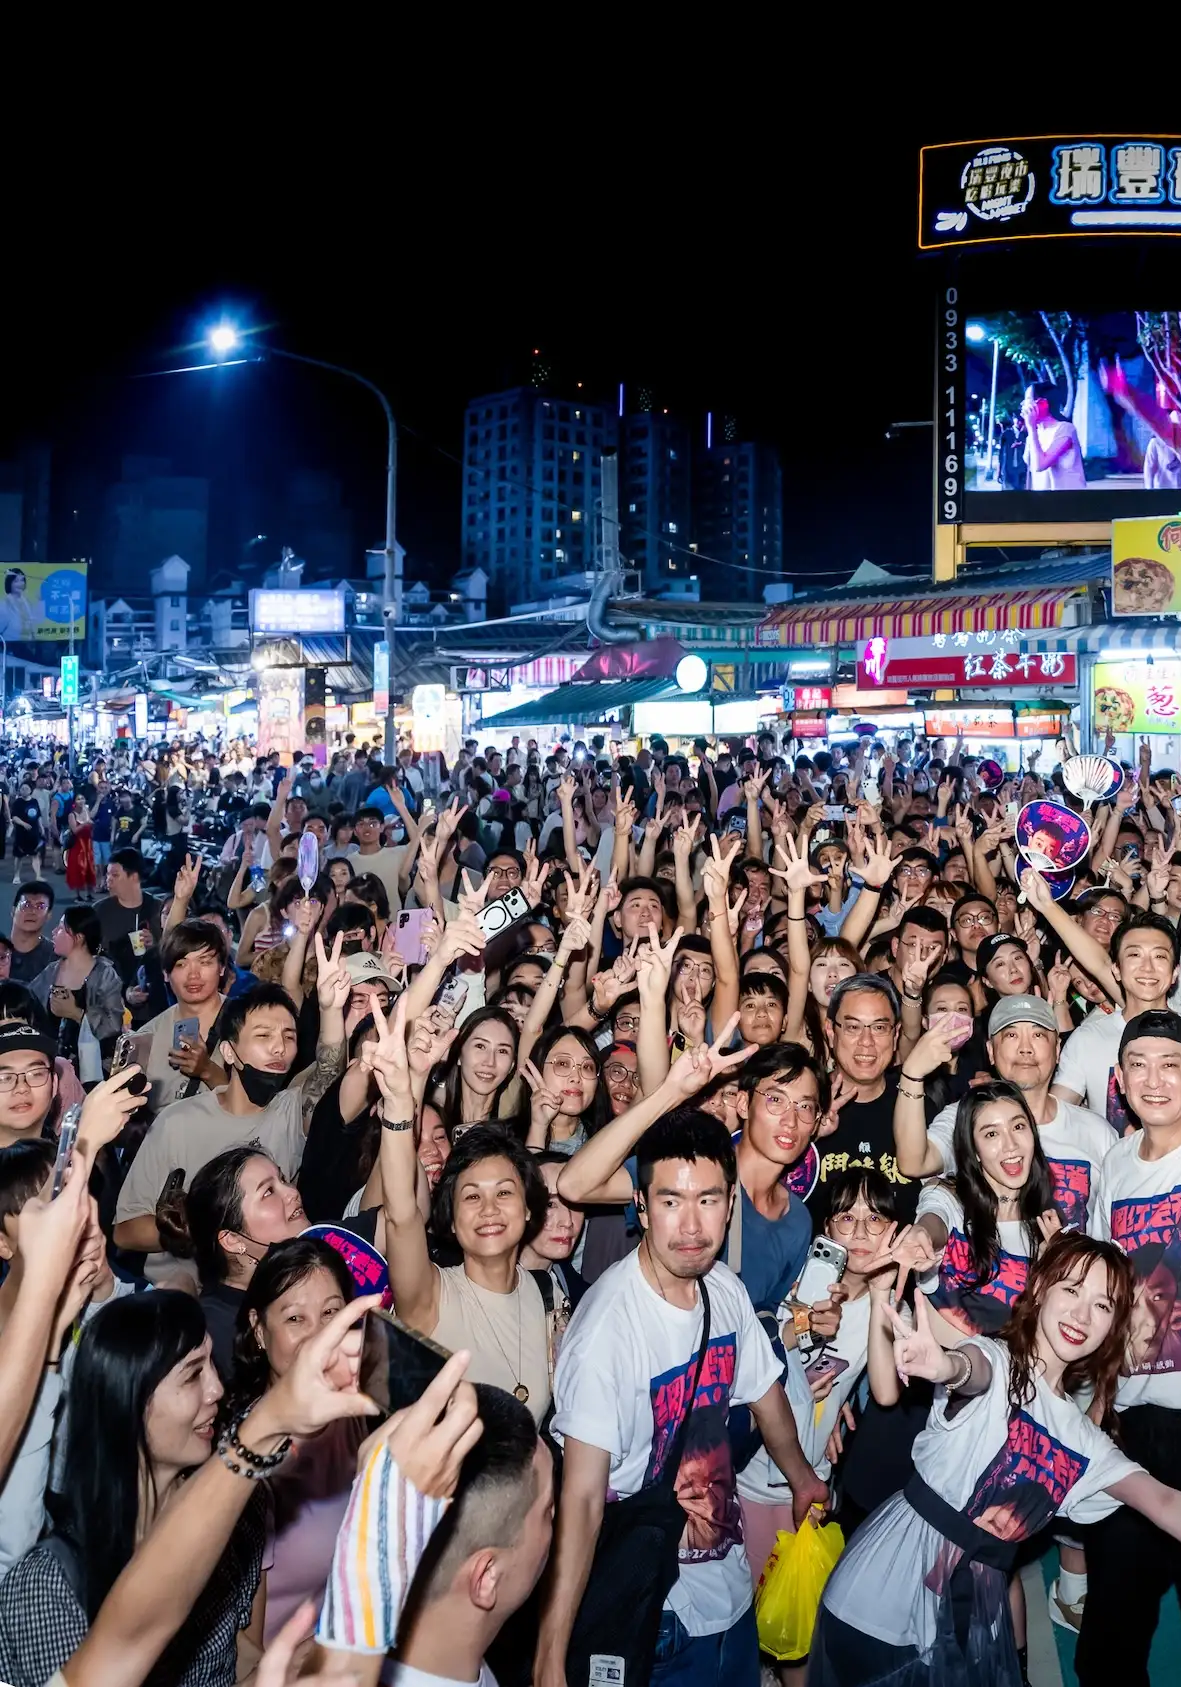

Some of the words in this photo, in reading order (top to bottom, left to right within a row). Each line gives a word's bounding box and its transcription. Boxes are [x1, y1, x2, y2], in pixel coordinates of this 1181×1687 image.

[944, 287, 959, 372] 0933
[943, 385, 959, 520] 111699
[963, 648, 1065, 681] 紅茶牛奶
